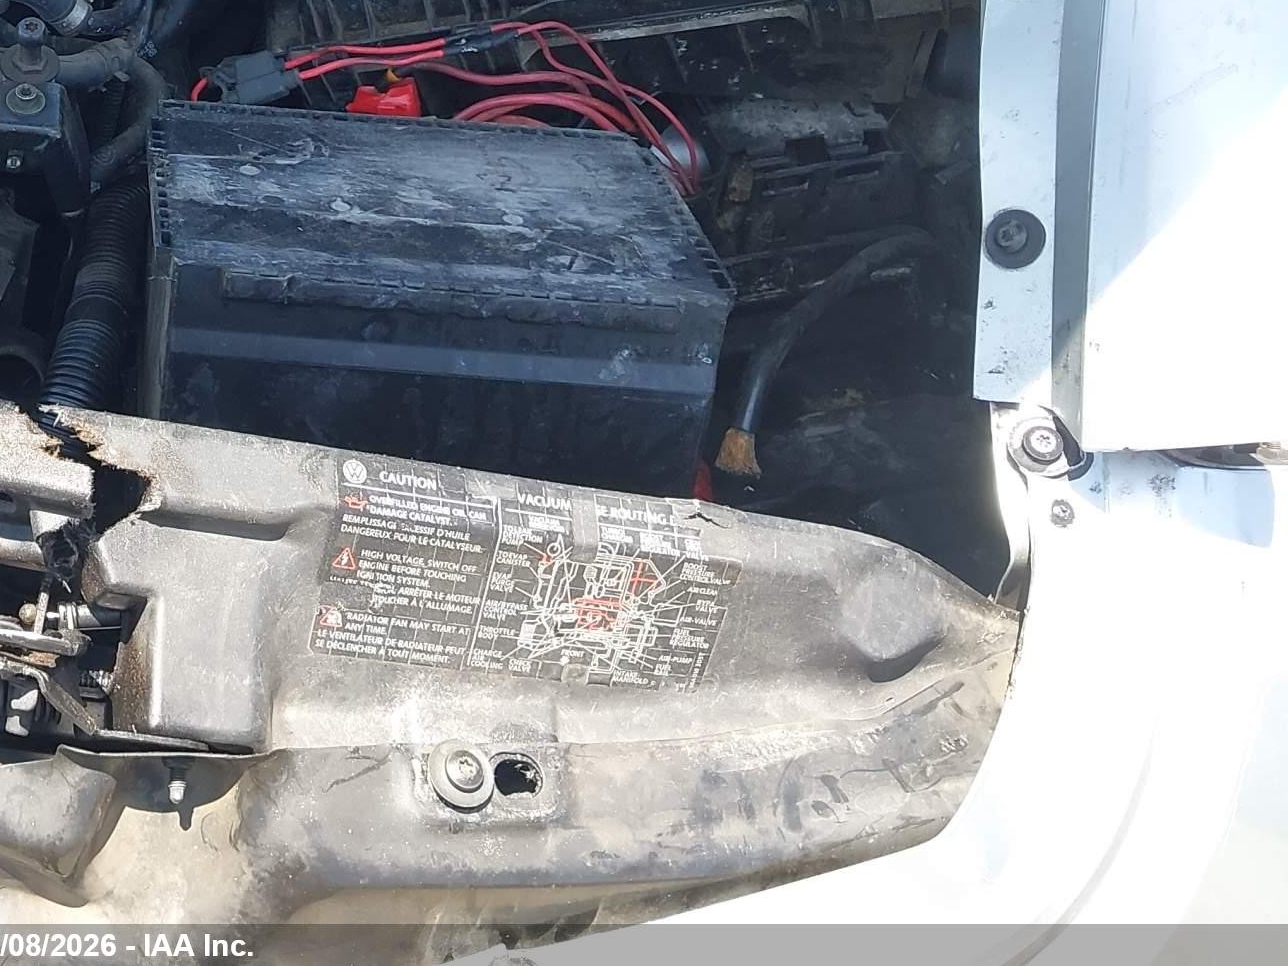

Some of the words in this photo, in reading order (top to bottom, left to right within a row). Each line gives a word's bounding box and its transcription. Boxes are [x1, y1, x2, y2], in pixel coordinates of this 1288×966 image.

[379, 470, 437, 491] CAUTION
[369, 505, 408, 519] DAMAGE
[420, 503, 450, 515] ENGINE
[452, 508, 466, 518] OIL
[469, 511, 486, 521] CAN
[518, 492, 572, 511] VACUUM
[610, 507, 666, 525] ROUTING
[341, 523, 392, 540] DANGEREUX
[393, 532, 418, 544] POUR
[418, 537, 428, 545] LE
[436, 528, 471, 542] D'HUILE
[361, 549, 383, 560] HIGH
[427, 559, 460, 571] SWITCH
[462, 564, 478, 573] OFF
[496, 556, 531, 567] CANISTER
[359, 560, 390, 572] ENGINE
[391, 565, 422, 577] BEFORE
[423, 569, 467, 583] TOUCHING
[396, 575, 430, 588] SYSTEM.
[490, 584, 513, 593] VALVE
[435, 592, 444, 600] LE
[445, 593, 480, 605] MOTEUR
[484, 606, 517, 616] CONTROL
[485, 600, 528, 611] AIR/BYPASS
[695, 605, 718, 613] VALVE
[483, 612, 506, 620] VALVE
[344, 621, 362, 632] ANY
[346, 612, 390, 626] RADIATOR
[391, 618, 408, 628] FAN
[409, 620, 430, 630] MAY
[431, 623, 458, 634] START
[458, 627, 471, 635] AT
[480, 625, 515, 635] THROTTLE
[478, 632, 498, 640] BODY
[317, 628, 326, 637] LE
[329, 630, 384, 646] VENTILATEUR
[385, 639, 396, 647] DE
[397, 640, 444, 653] RADIATEUR
[445, 646, 466, 656] PEUT
[669, 640, 710, 649] REGULATOR
[315, 638, 325, 647] SE
[387, 649, 410, 658] TOUT
[474, 649, 502, 658] CHARGE
[471, 660, 503, 670] COOLING
[508, 665, 531, 673] VALVE
[614, 670, 639, 678] INTAKE
[612, 676, 648, 684] MANIFOLD
